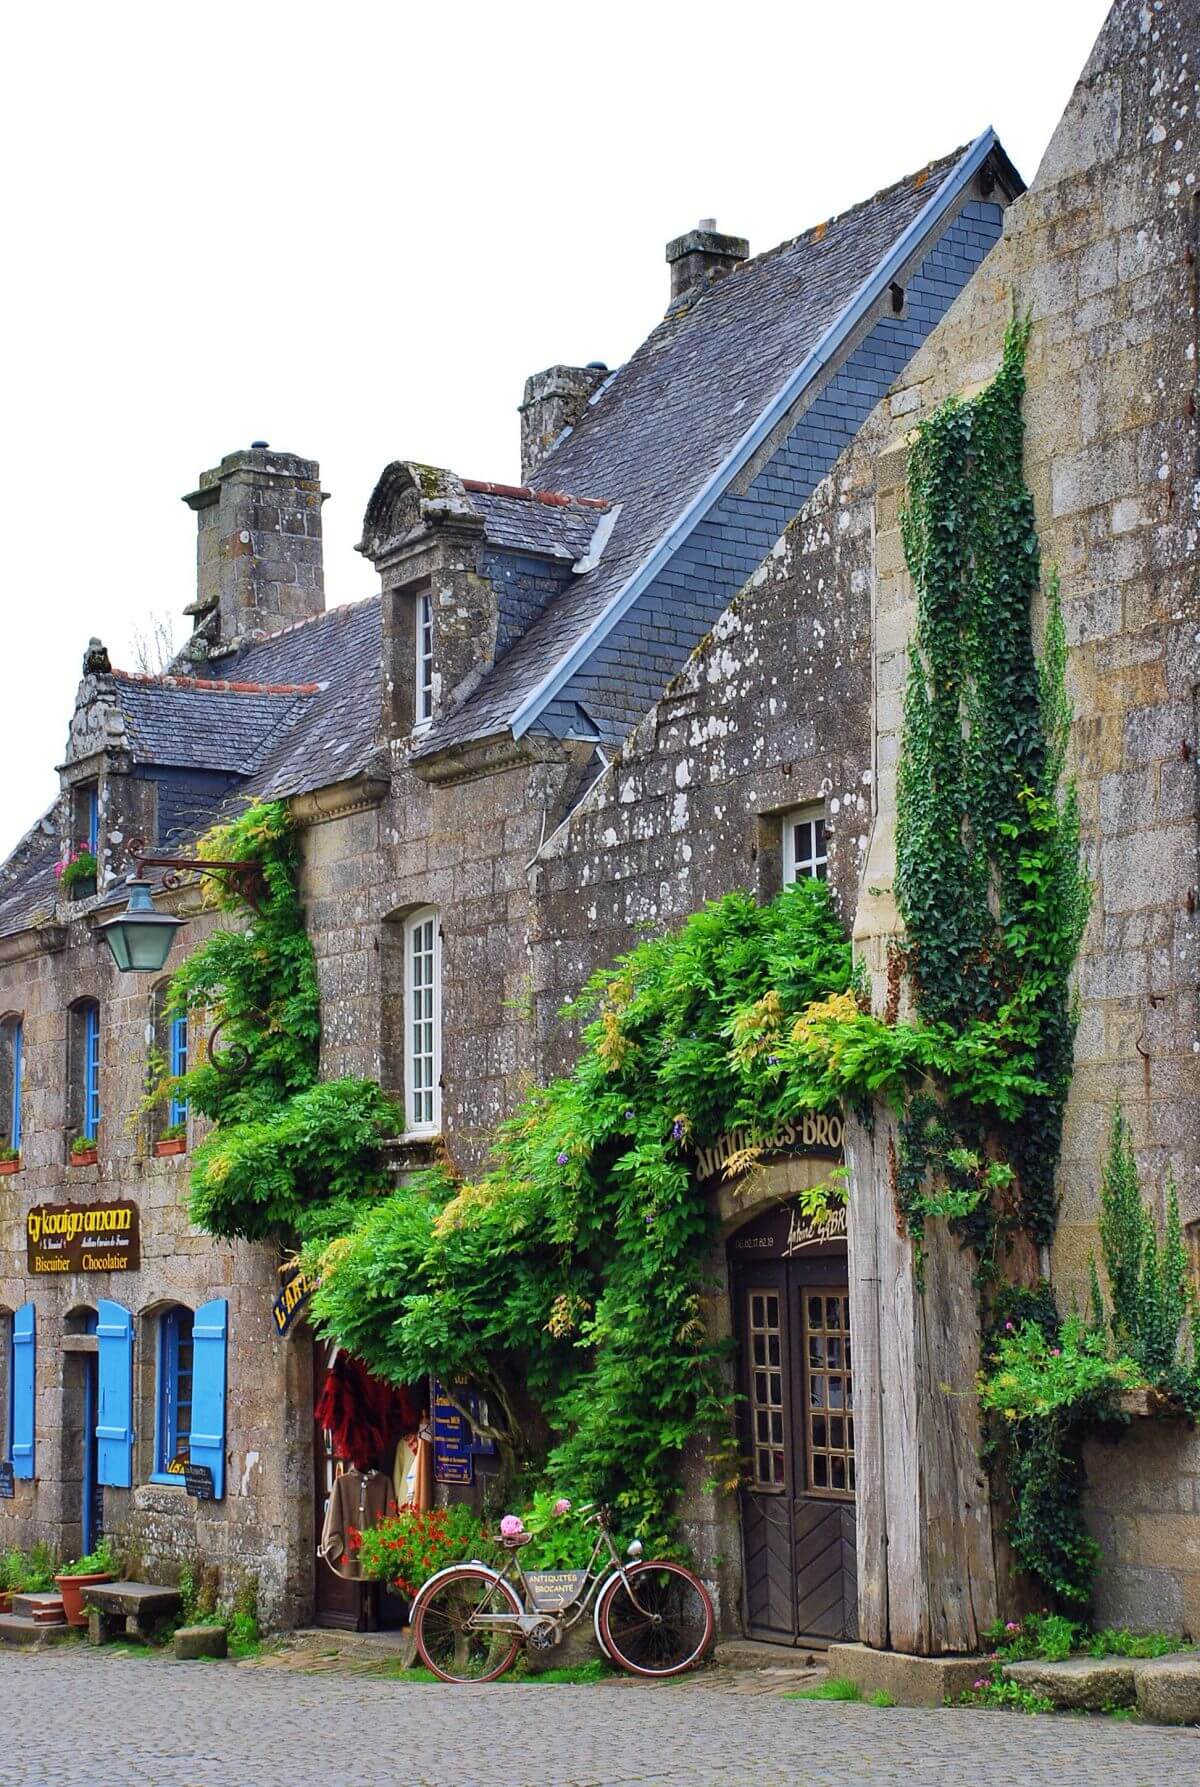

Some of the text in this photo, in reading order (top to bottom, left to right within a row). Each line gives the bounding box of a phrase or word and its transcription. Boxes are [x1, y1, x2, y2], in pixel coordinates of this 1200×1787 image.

[84, 1209, 132, 1232] amann
[35, 1252, 128, 1272] Biscuitier Chocolatier
[528, 1574, 577, 1584] ANTIQUITES
[535, 1584, 574, 1593] BROCANTE
